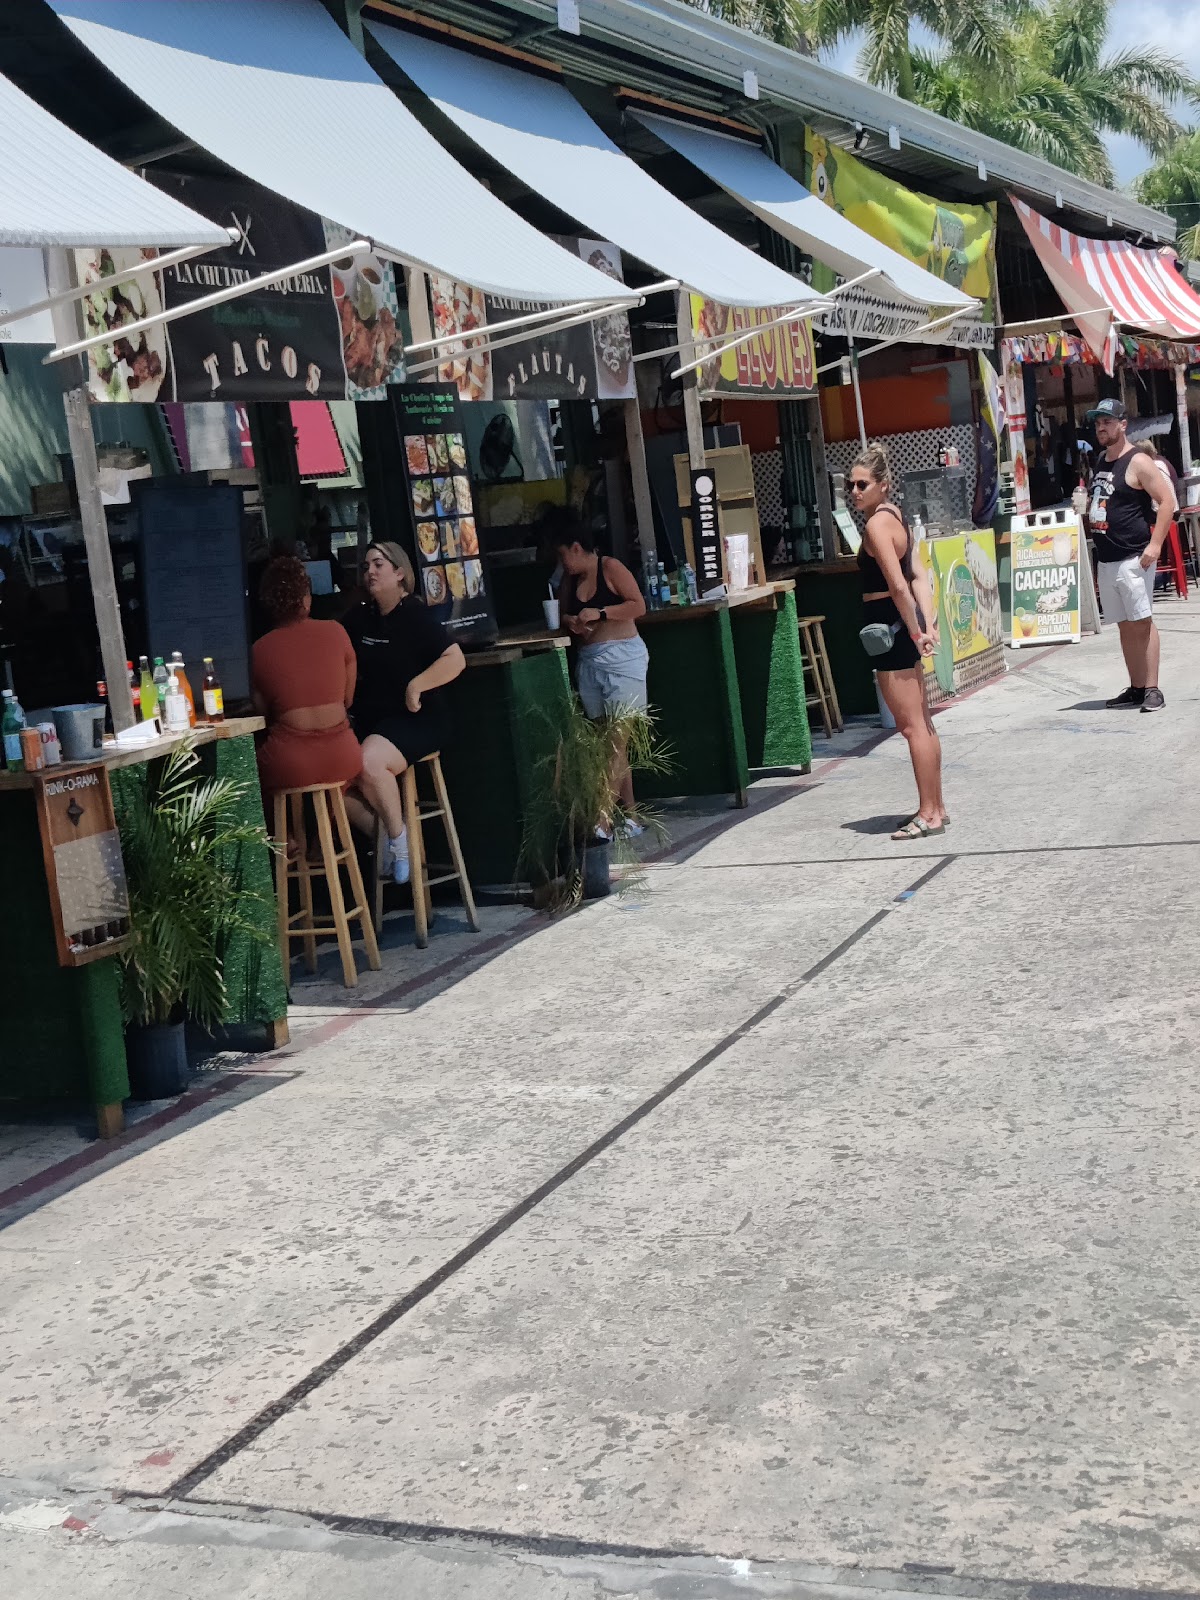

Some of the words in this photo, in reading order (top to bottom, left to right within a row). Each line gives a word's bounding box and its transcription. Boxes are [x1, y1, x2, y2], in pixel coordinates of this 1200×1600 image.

[733, 305, 814, 390] ELOTES
[203, 337, 321, 395] TACOS
[698, 496, 716, 537] ORDER
[702, 546, 718, 578] HERE
[1016, 548, 1033, 561] RICA
[1015, 566, 1076, 592] CACHAPA
[1037, 612, 1071, 626] PAPELON
